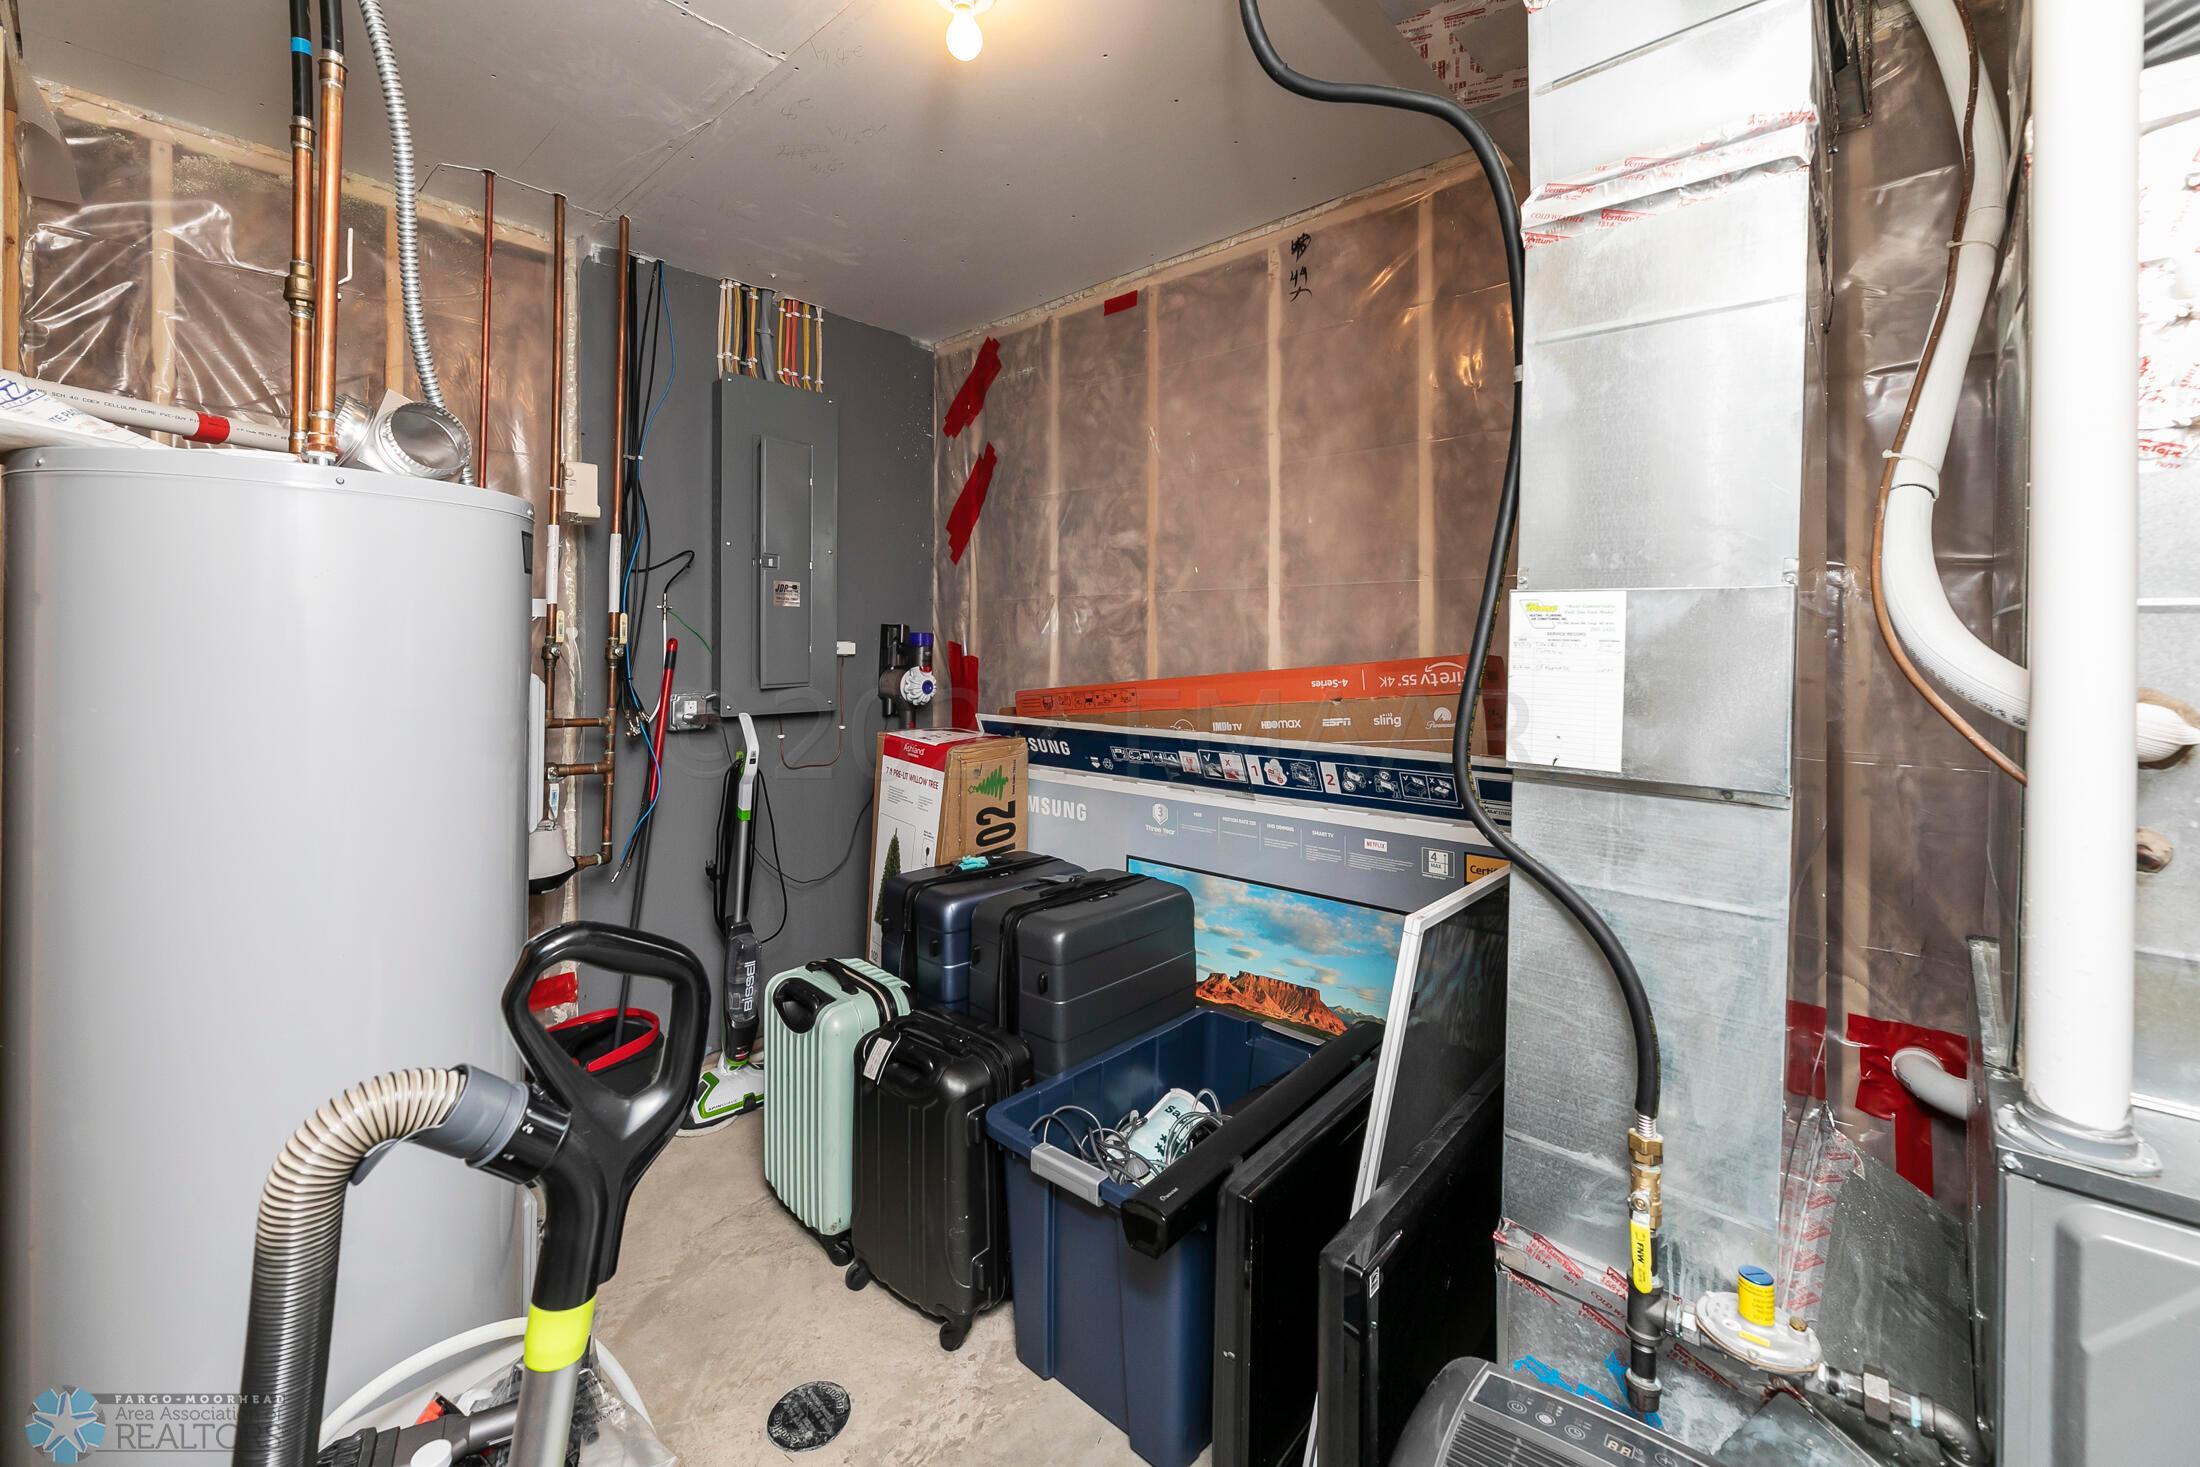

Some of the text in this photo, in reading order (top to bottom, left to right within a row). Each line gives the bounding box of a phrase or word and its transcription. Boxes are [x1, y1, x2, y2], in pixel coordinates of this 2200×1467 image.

[1311, 678, 1349, 688] 4-Series
[1378, 676, 1395, 688] 4K
[1322, 717, 1351, 727] ESPN
[1373, 712, 1402, 728] sling
[903, 743, 925, 756] Ashland
[1027, 737, 1071, 756] SUNG
[893, 768, 909, 780] PRE-LIT
[909, 771, 928, 786] WILLOW
[928, 776, 939, 790] TREE
[1325, 773, 1337, 786] 2
[1027, 794, 1087, 822] MSUNG
[1366, 840, 1386, 850] NETFLIX
[1430, 852, 1438, 862] 4
[1635, 1241, 1645, 1265] FNW
